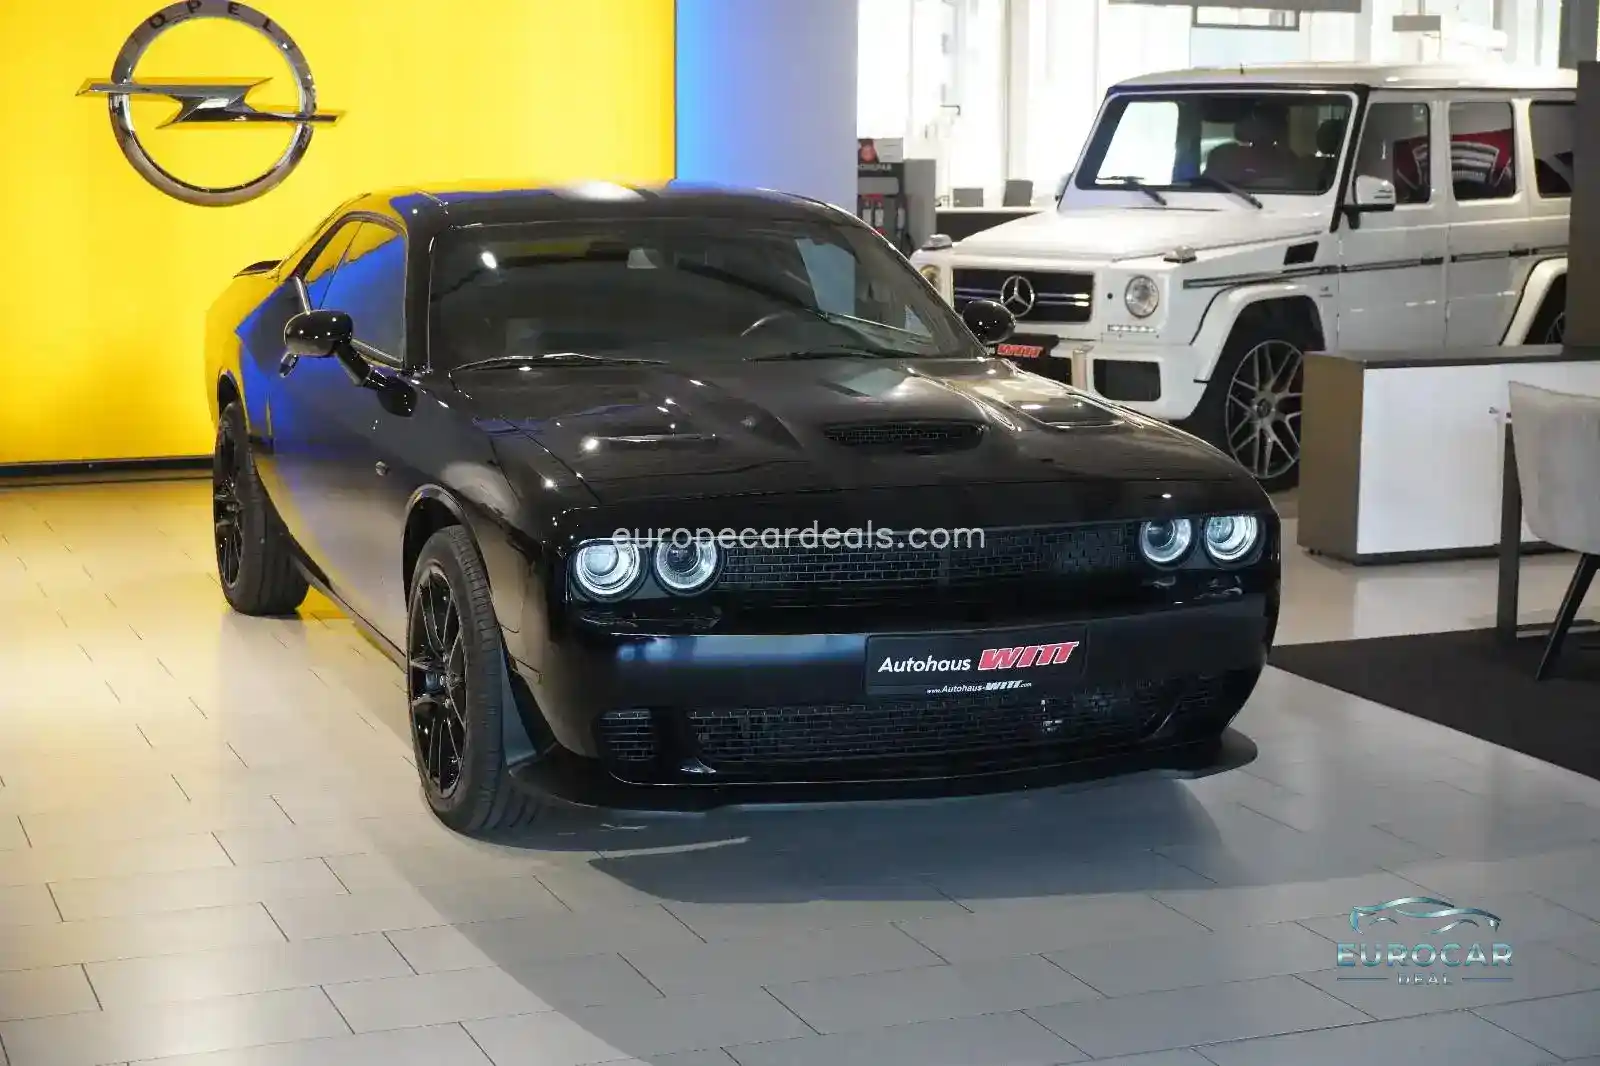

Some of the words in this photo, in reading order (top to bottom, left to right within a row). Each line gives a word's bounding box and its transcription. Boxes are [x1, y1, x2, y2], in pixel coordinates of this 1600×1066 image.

[150, 0, 273, 32] OPEL
[878, 655, 971, 673] Autohaus
[978, 641, 1080, 670] WITT
